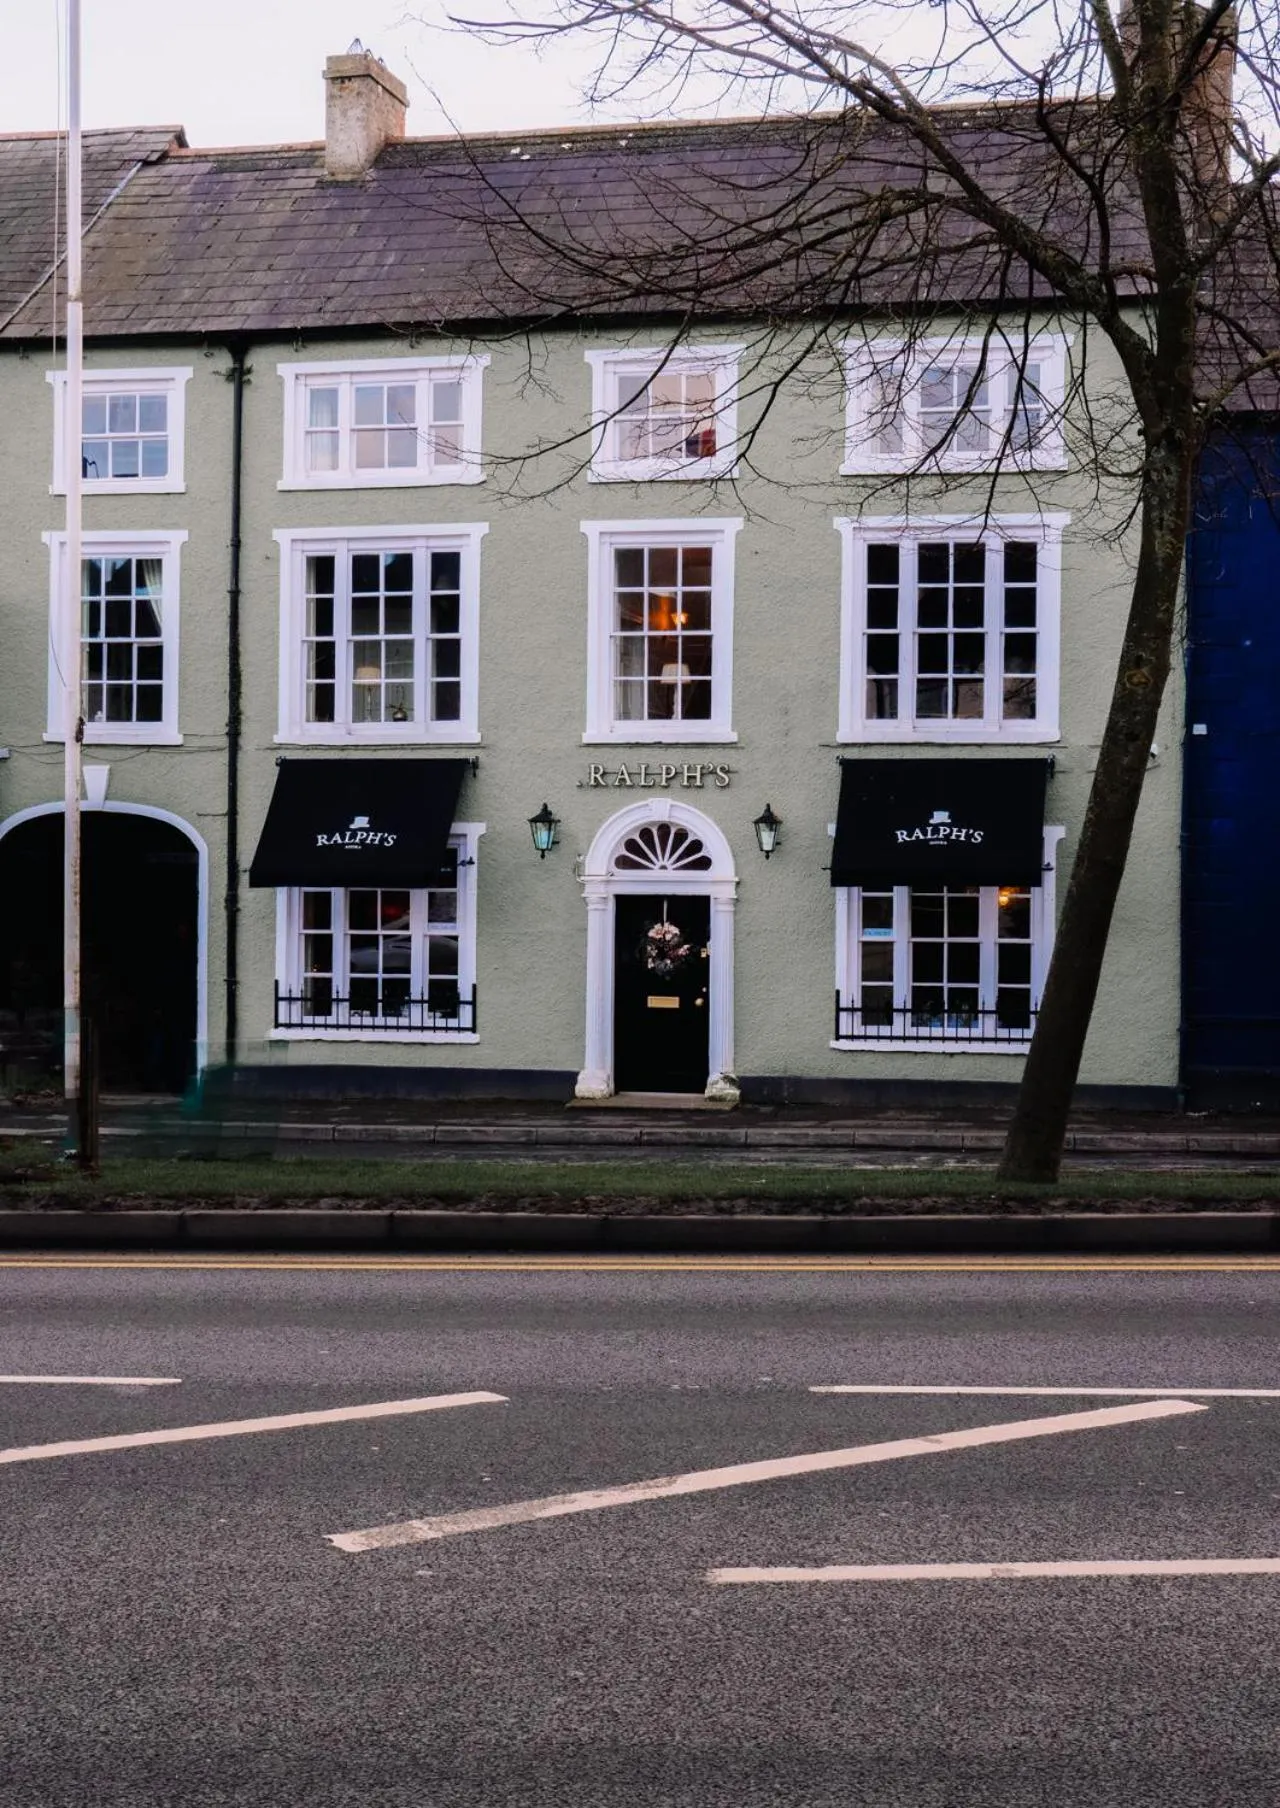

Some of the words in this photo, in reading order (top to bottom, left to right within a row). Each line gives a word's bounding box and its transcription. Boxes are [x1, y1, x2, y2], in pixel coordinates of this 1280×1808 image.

[589, 762, 730, 787] RALPH'S
[316, 831, 397, 847] RALPH'S
[895, 826, 984, 844] RALPH'S
